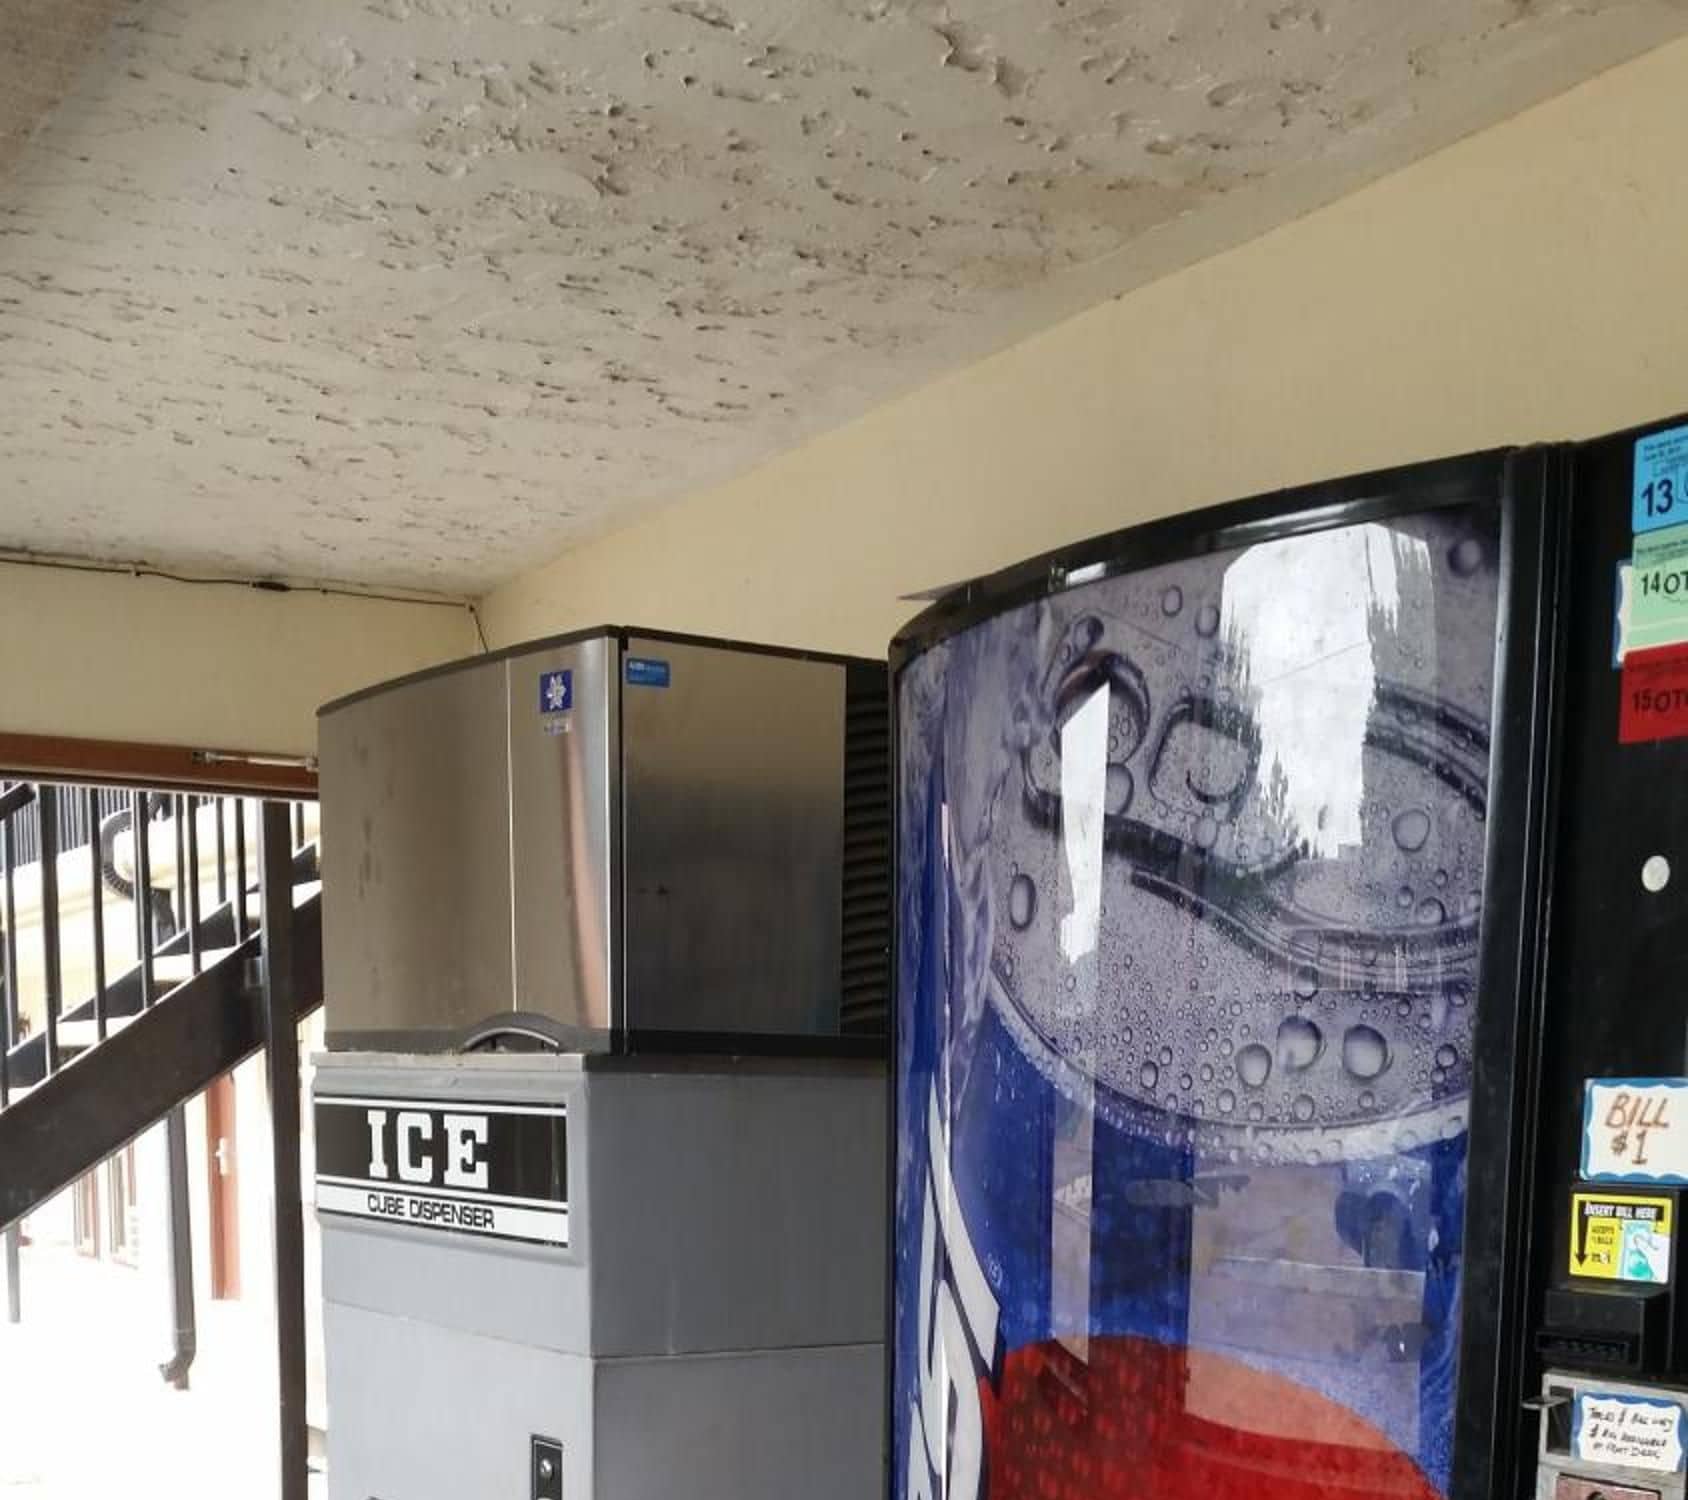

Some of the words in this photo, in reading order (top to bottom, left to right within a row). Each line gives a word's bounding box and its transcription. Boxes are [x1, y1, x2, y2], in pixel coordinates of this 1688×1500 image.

[1641, 478, 1673, 517] 13
[1605, 1092, 1669, 1129] BILL
[367, 1108, 489, 1189] ICE
[367, 1194, 405, 1217] CUBE
[409, 1200, 495, 1229] DISPENSER
